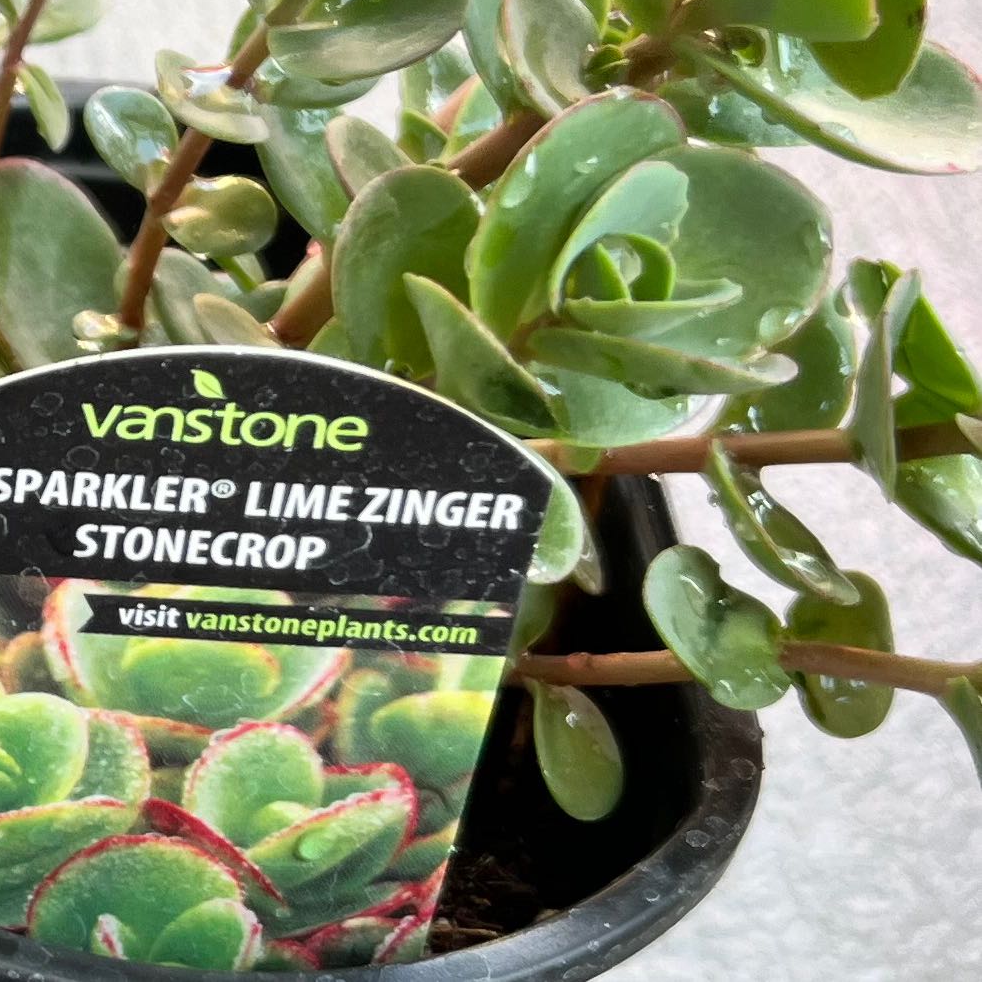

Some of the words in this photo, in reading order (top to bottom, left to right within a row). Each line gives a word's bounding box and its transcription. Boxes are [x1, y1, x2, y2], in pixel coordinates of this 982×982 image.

[80, 401, 368, 451] vanstone
[243, 481, 351, 522] LIME
[357, 487, 524, 530] ZINGER
[73, 524, 326, 570] STONECROP
[118, 604, 180, 629] visit
[185, 611, 478, 645] vanstoneplants.com
